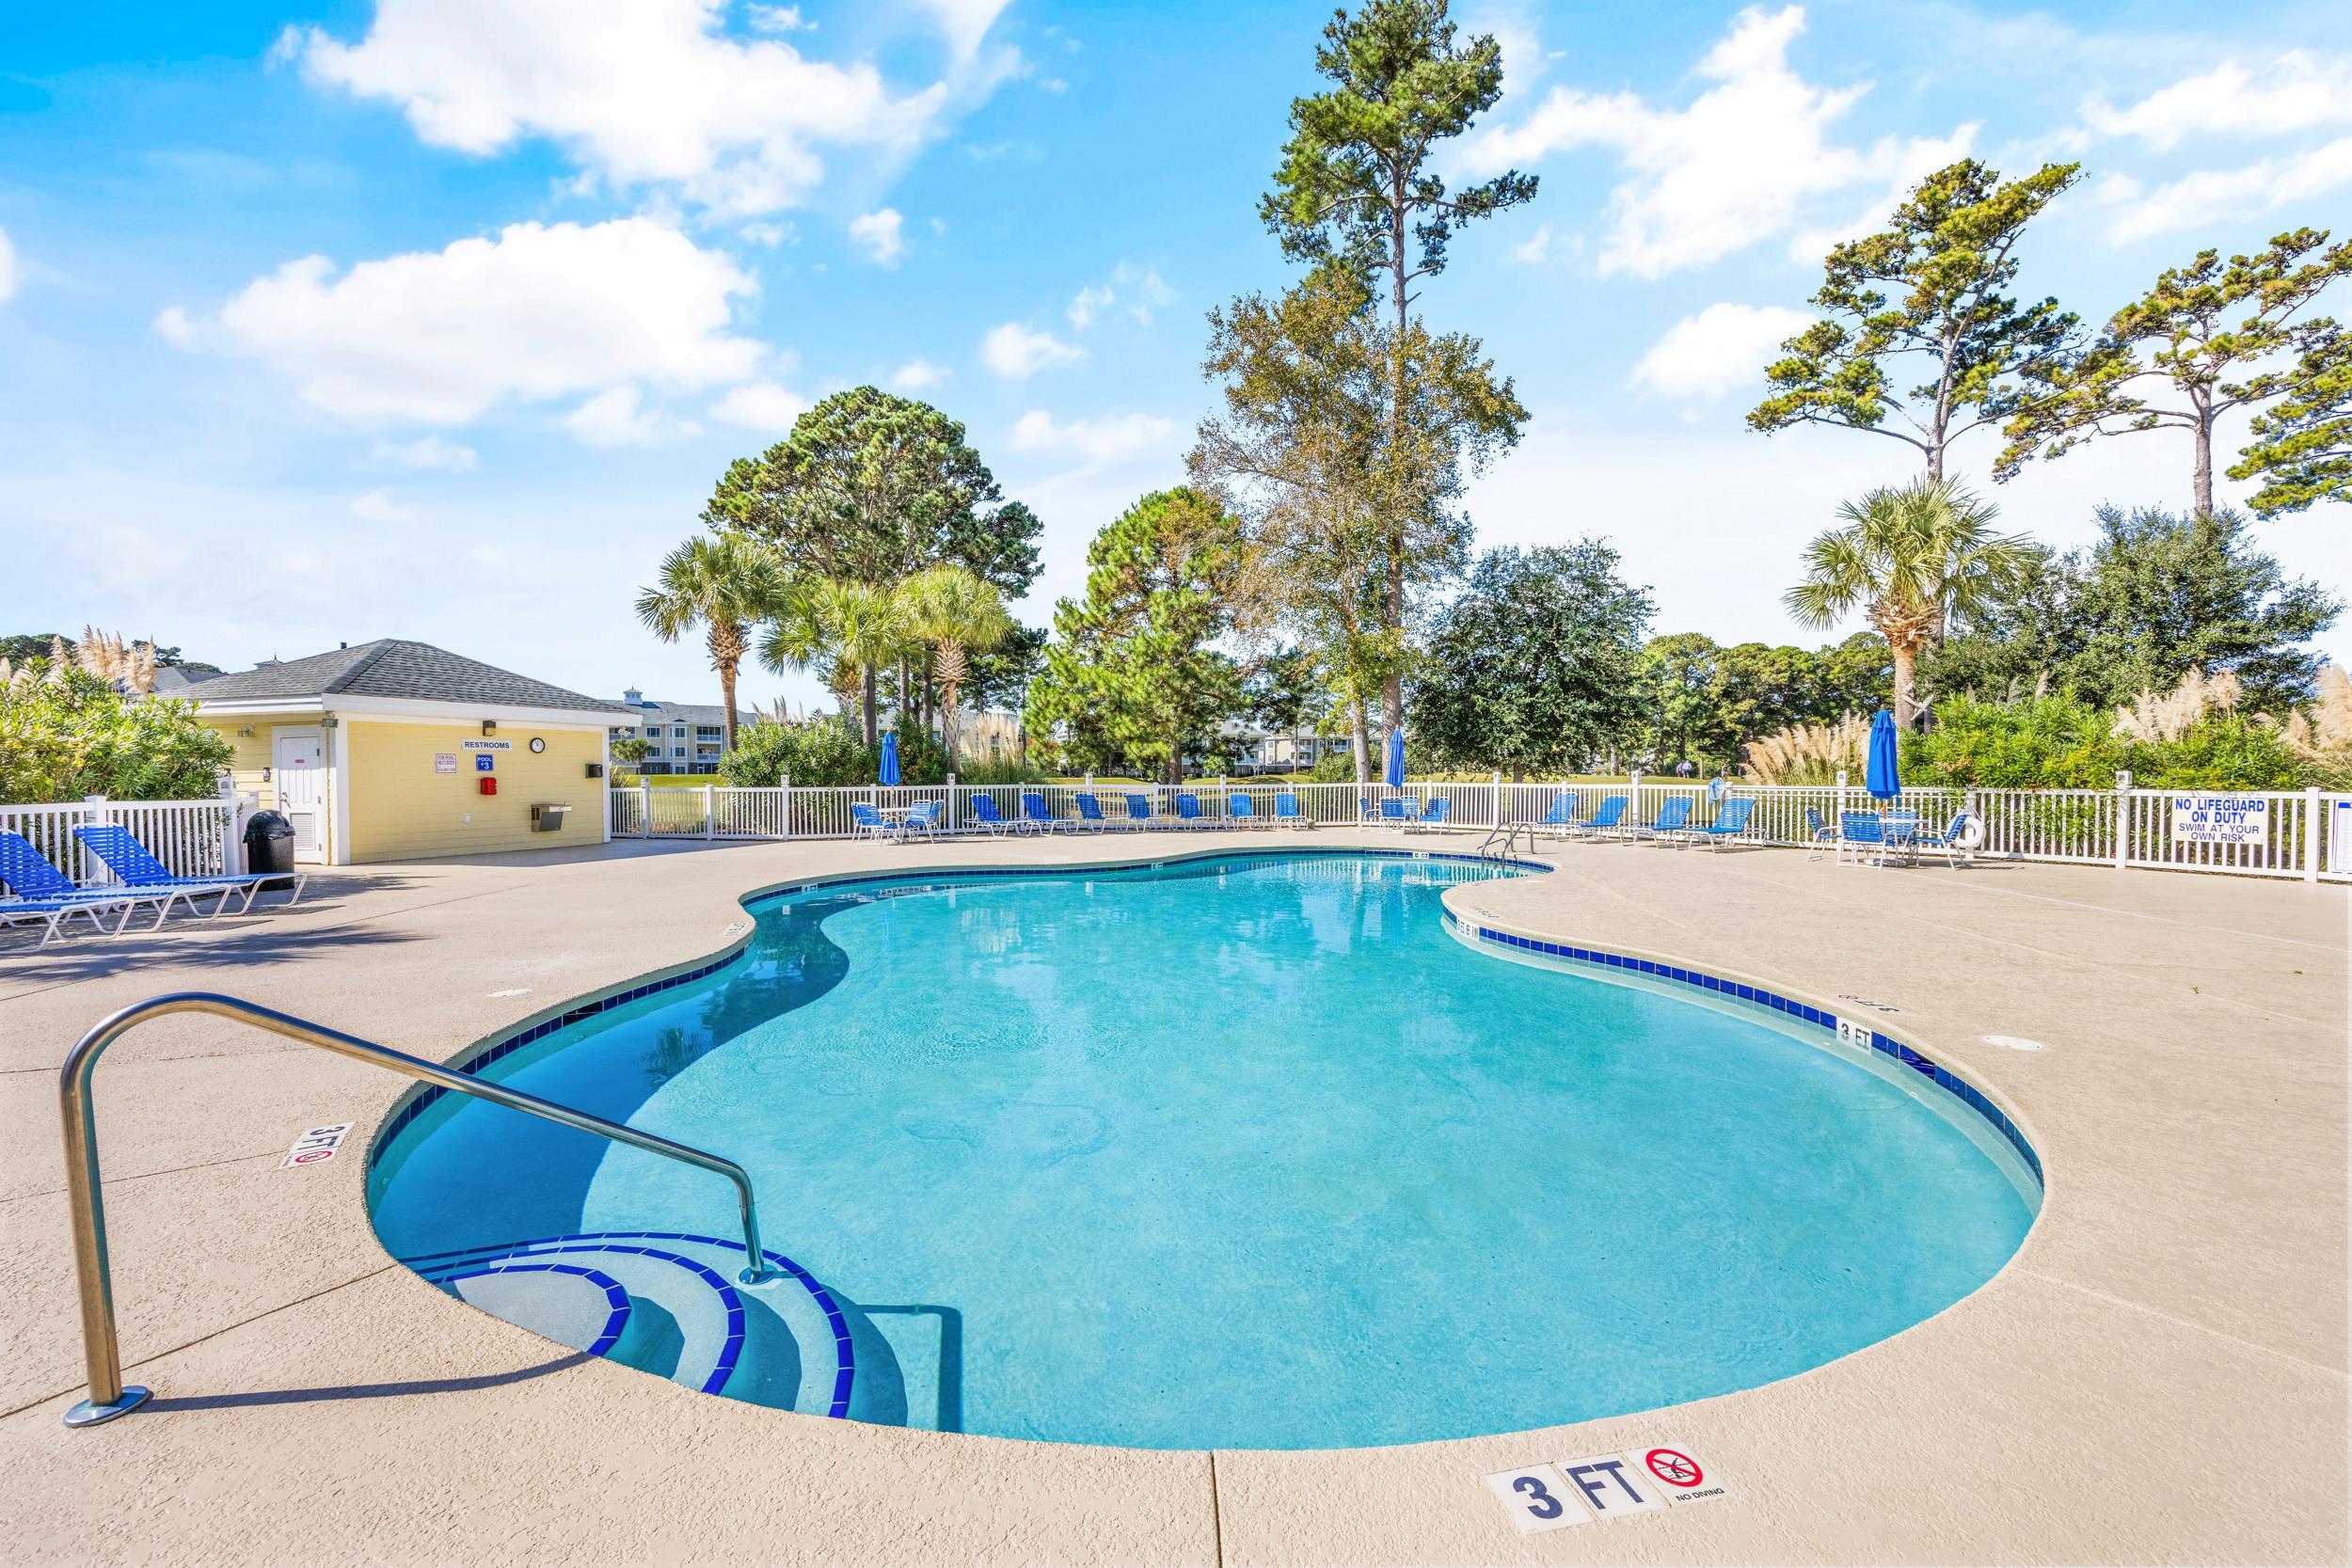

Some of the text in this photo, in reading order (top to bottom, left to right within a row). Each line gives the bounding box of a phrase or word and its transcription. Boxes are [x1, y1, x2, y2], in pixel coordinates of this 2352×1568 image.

[2175, 799, 2265, 812] NO LIFEGUARD
[2191, 811, 2246, 824] ON DUTY
[2179, 823, 2260, 833] SWIM AT YOUR
[2220, 833, 2245, 842] RISK
[1841, 1022, 1870, 1047] 3 FT
[297, 1126, 345, 1150] 3 FT
[1513, 1460, 1645, 1519] 3 FT
[1692, 1488, 1725, 1498] DIVING
